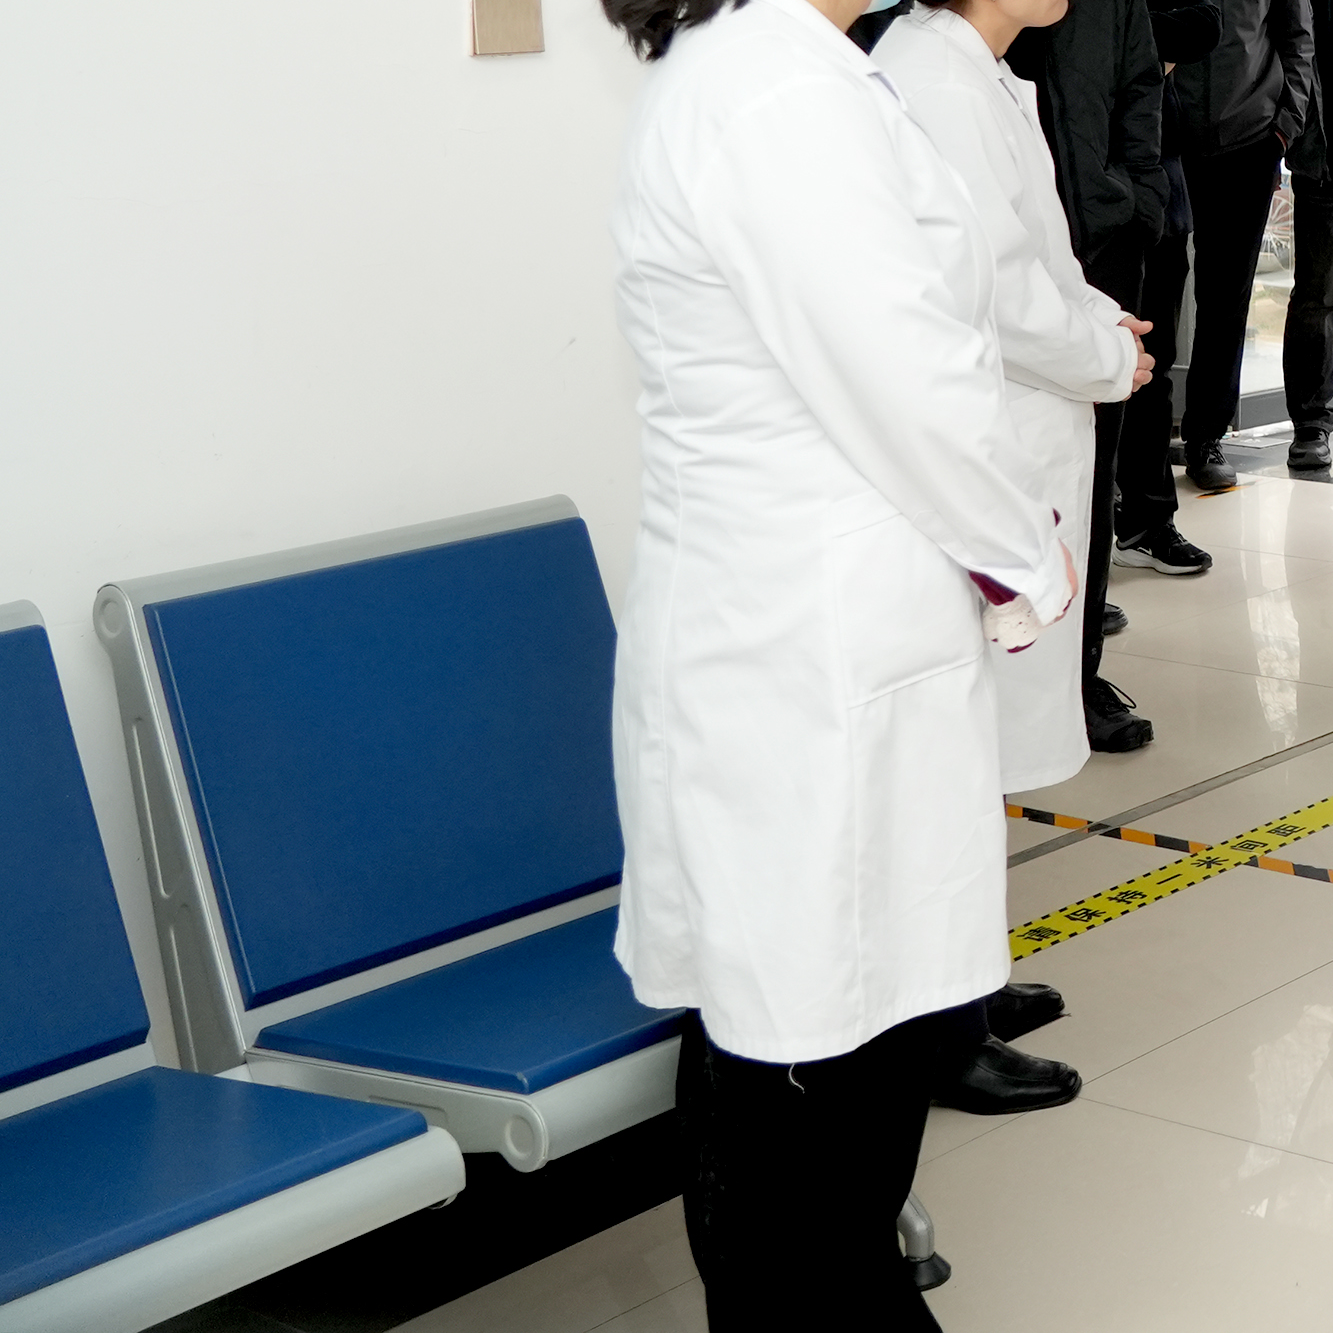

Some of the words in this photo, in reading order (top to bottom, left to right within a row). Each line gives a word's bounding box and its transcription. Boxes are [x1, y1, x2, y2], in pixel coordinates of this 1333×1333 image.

[1016, 823, 1306, 942] 请保持一米间距
